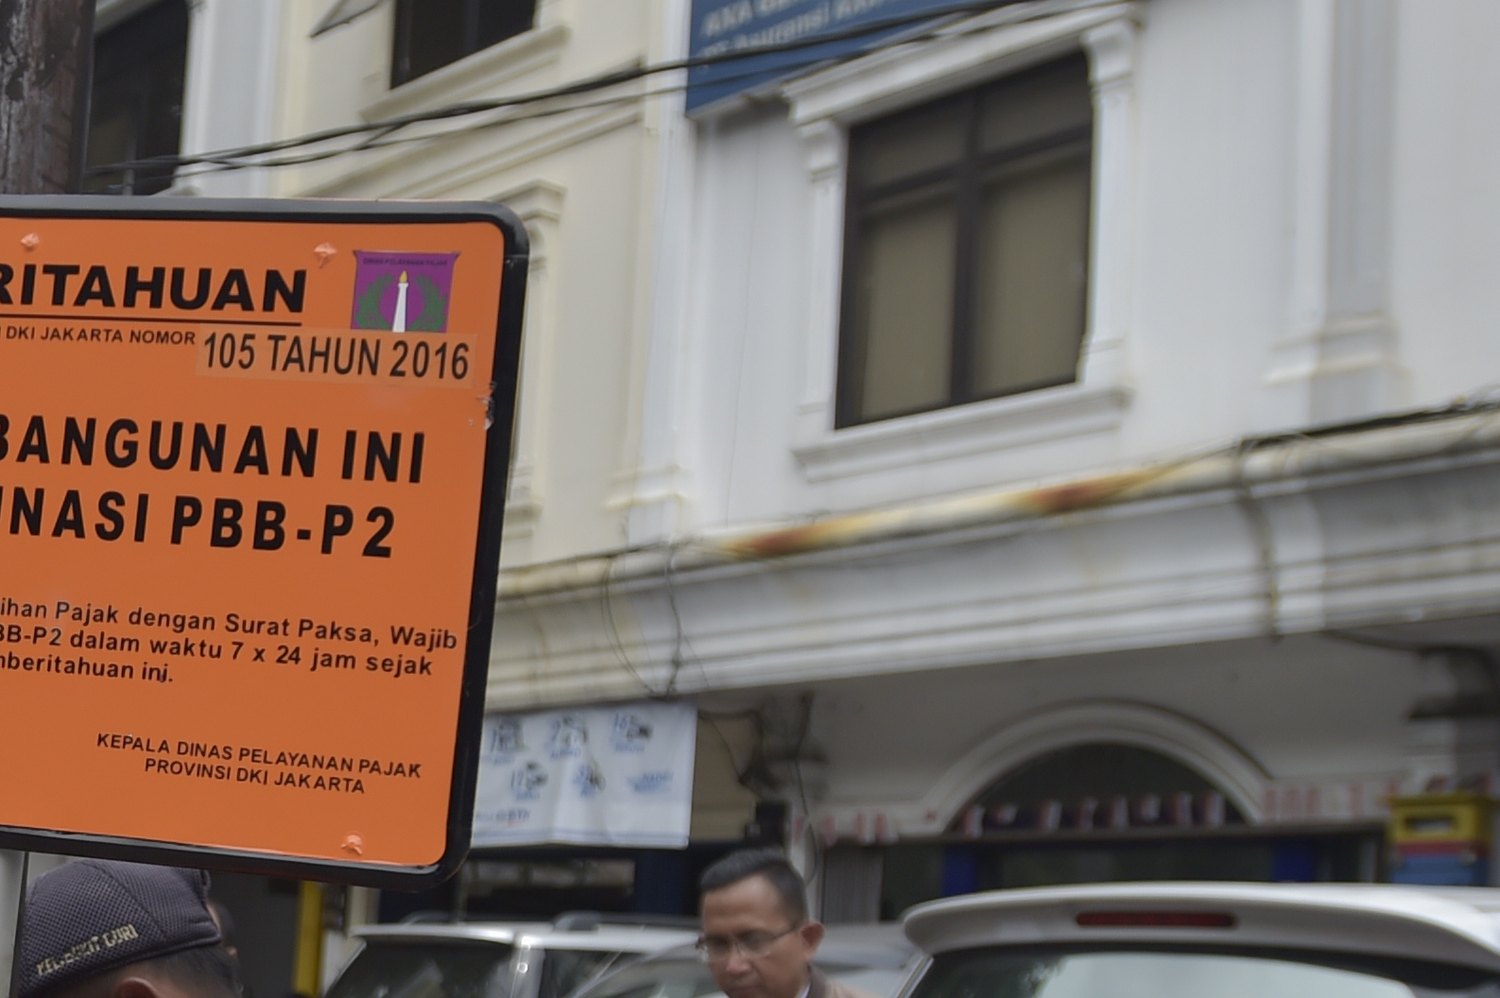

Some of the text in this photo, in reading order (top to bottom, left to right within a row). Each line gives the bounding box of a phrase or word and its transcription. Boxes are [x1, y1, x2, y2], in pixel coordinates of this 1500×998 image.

[6, 325, 35, 340] DKI
[40, 327, 123, 343] JAKARTA
[129, 330, 196, 345] NOMOR
[204, 332, 256, 370] 105
[267, 334, 381, 376] TAHUN
[389, 340, 469, 380] 2016
[341, 429, 425, 484] INI
[170, 495, 395, 558] PBB-P2
[55, 601, 118, 627] Pajak
[128, 607, 216, 634] dengan
[224, 612, 290, 637] Surat
[298, 618, 379, 647] Paksa,
[390, 625, 457, 652] Wajib
[70, 629, 140, 652] dalam
[149, 637, 222, 659] waktu
[231, 641, 244, 660] 7
[253, 648, 266, 662] x
[276, 644, 301, 665] 24
[310, 647, 357, 671] jam
[366, 653, 432, 677] sejak
[141, 661, 173, 683] ini.
[97, 733, 421, 778] KEPALA DINAS PELAYANAN PAJAK
[145, 757, 365, 794] PROVINSI DKI JAKARTA
